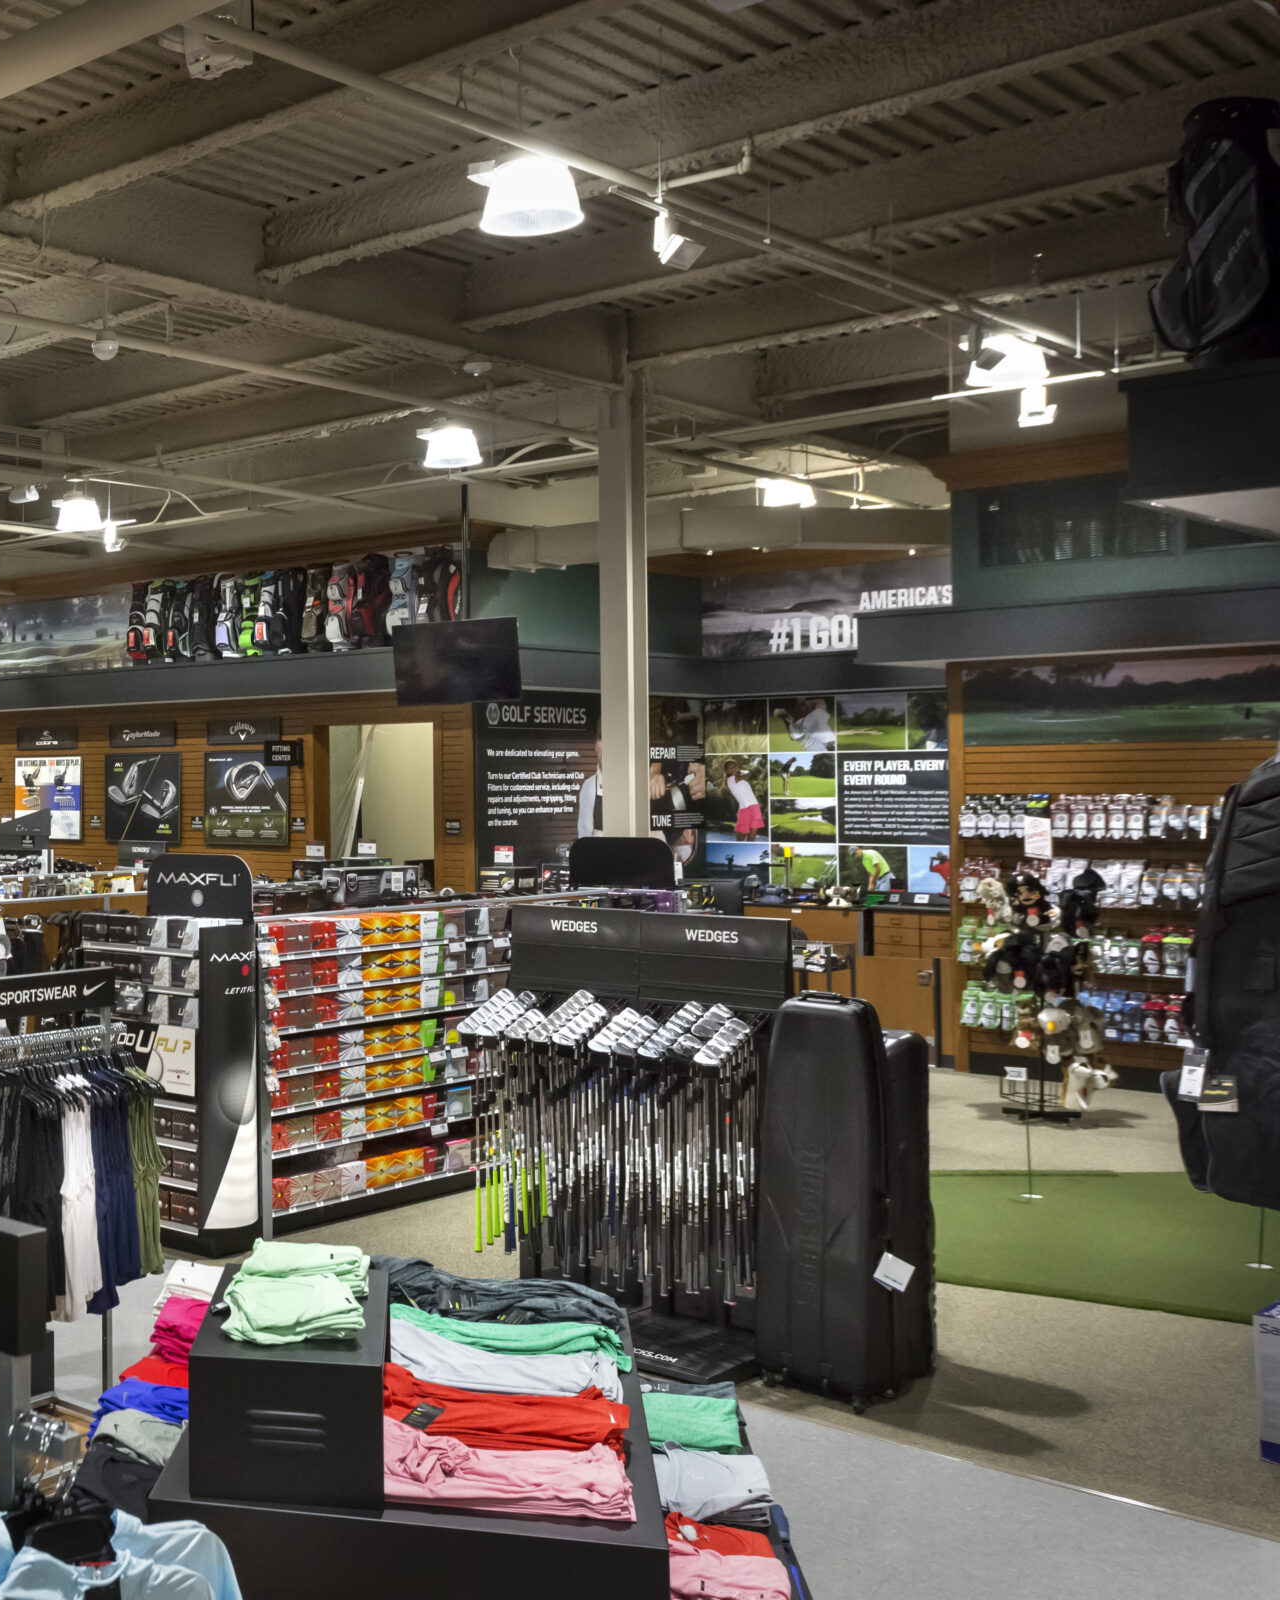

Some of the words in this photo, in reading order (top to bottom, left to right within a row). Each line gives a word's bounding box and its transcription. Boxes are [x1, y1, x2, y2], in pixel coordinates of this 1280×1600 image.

[859, 585, 953, 610] AMERICA'S
[769, 617, 802, 653] #1
[502, 705, 531, 722] GOLF
[534, 707, 586, 724] SERVICES
[122, 730, 160, 741] TaylorMade
[487, 749, 495, 757] We
[505, 749, 527, 757] dedicated
[555, 750, 565, 758] your
[650, 747, 676, 759] REPAIR
[844, 761, 872, 771] EVERY
[874, 760, 913, 771] PLAYER,
[914, 760, 945, 770] EVERY
[844, 775, 872, 785] EVERY
[874, 774, 906, 785] ROUND
[652, 815, 671, 827] TUNE
[157, 872, 237, 887] MAXFLI
[550, 919, 598, 933] WEDGES
[685, 929, 739, 944] WEDGES
[0, 985, 77, 1006] SPORTSWEAR
[135, 1030, 156, 1053] U
